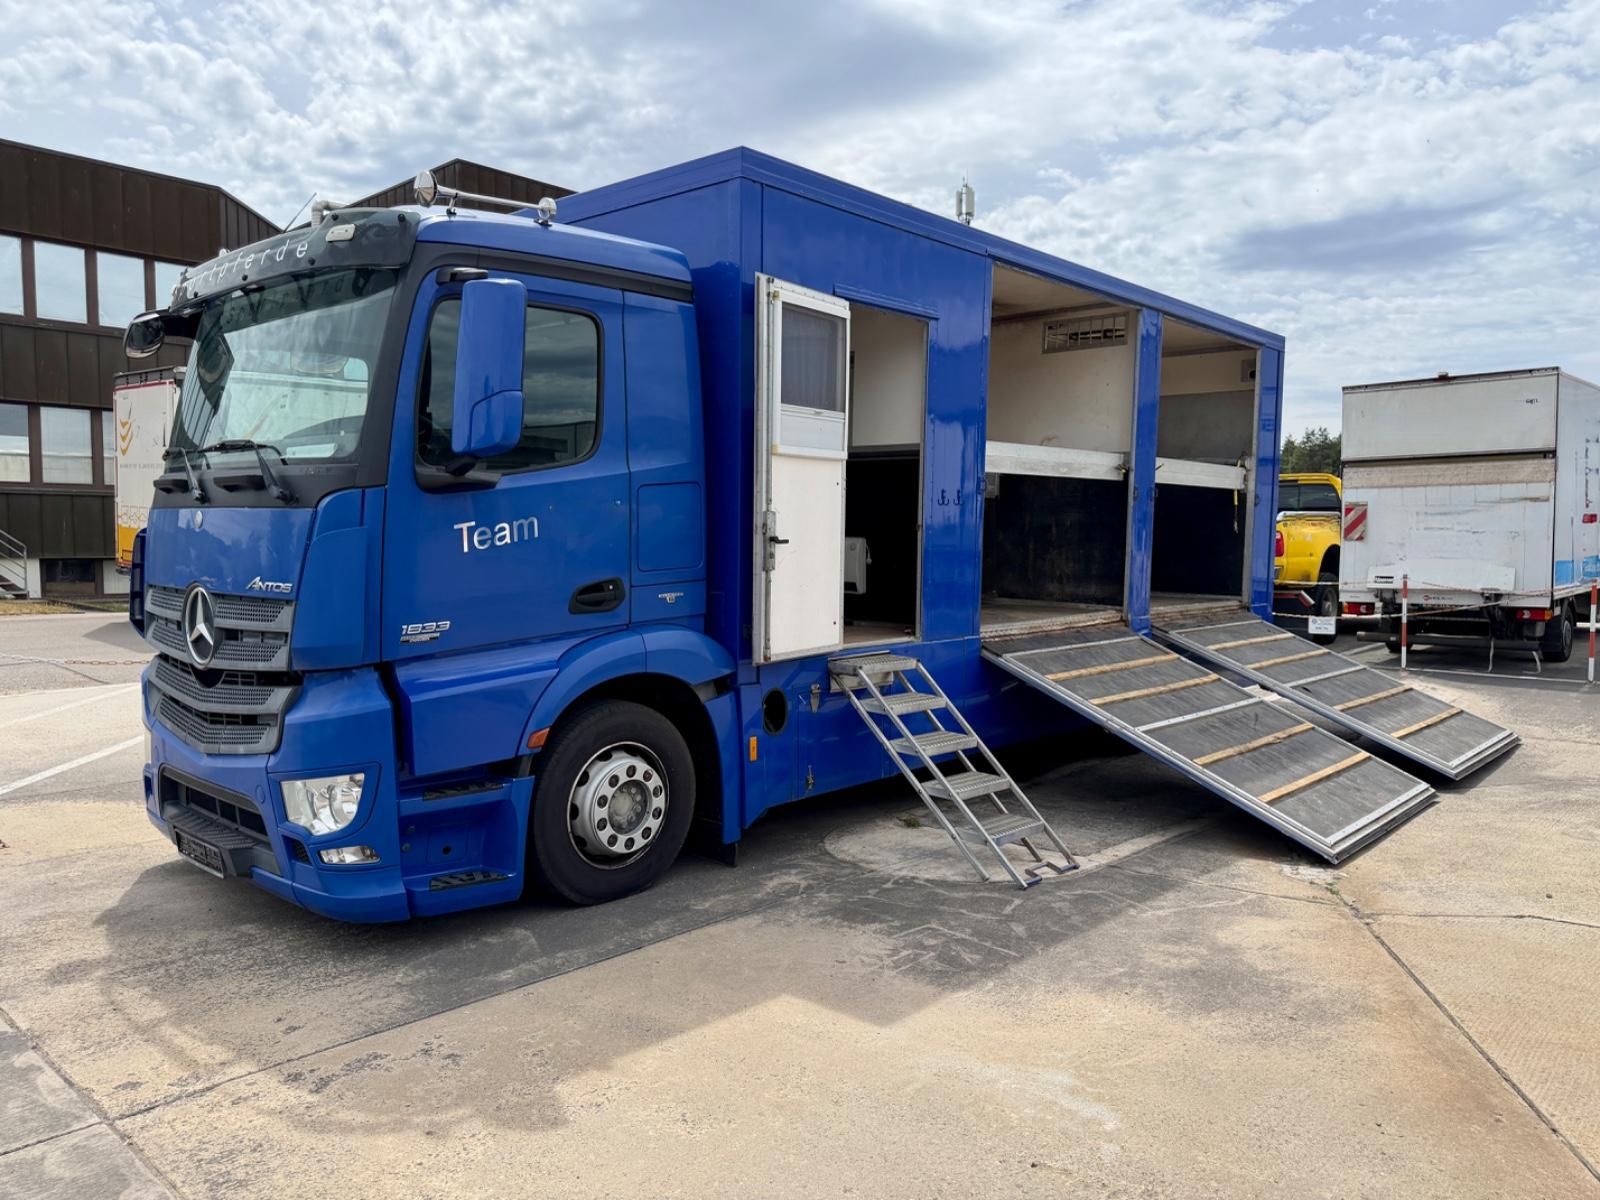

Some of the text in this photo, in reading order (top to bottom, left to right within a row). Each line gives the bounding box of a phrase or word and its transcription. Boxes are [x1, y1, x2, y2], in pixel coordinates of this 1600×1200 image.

[172, 239, 308, 300] ortpferde
[453, 516, 539, 553] Team
[401, 620, 451, 635] 1833
